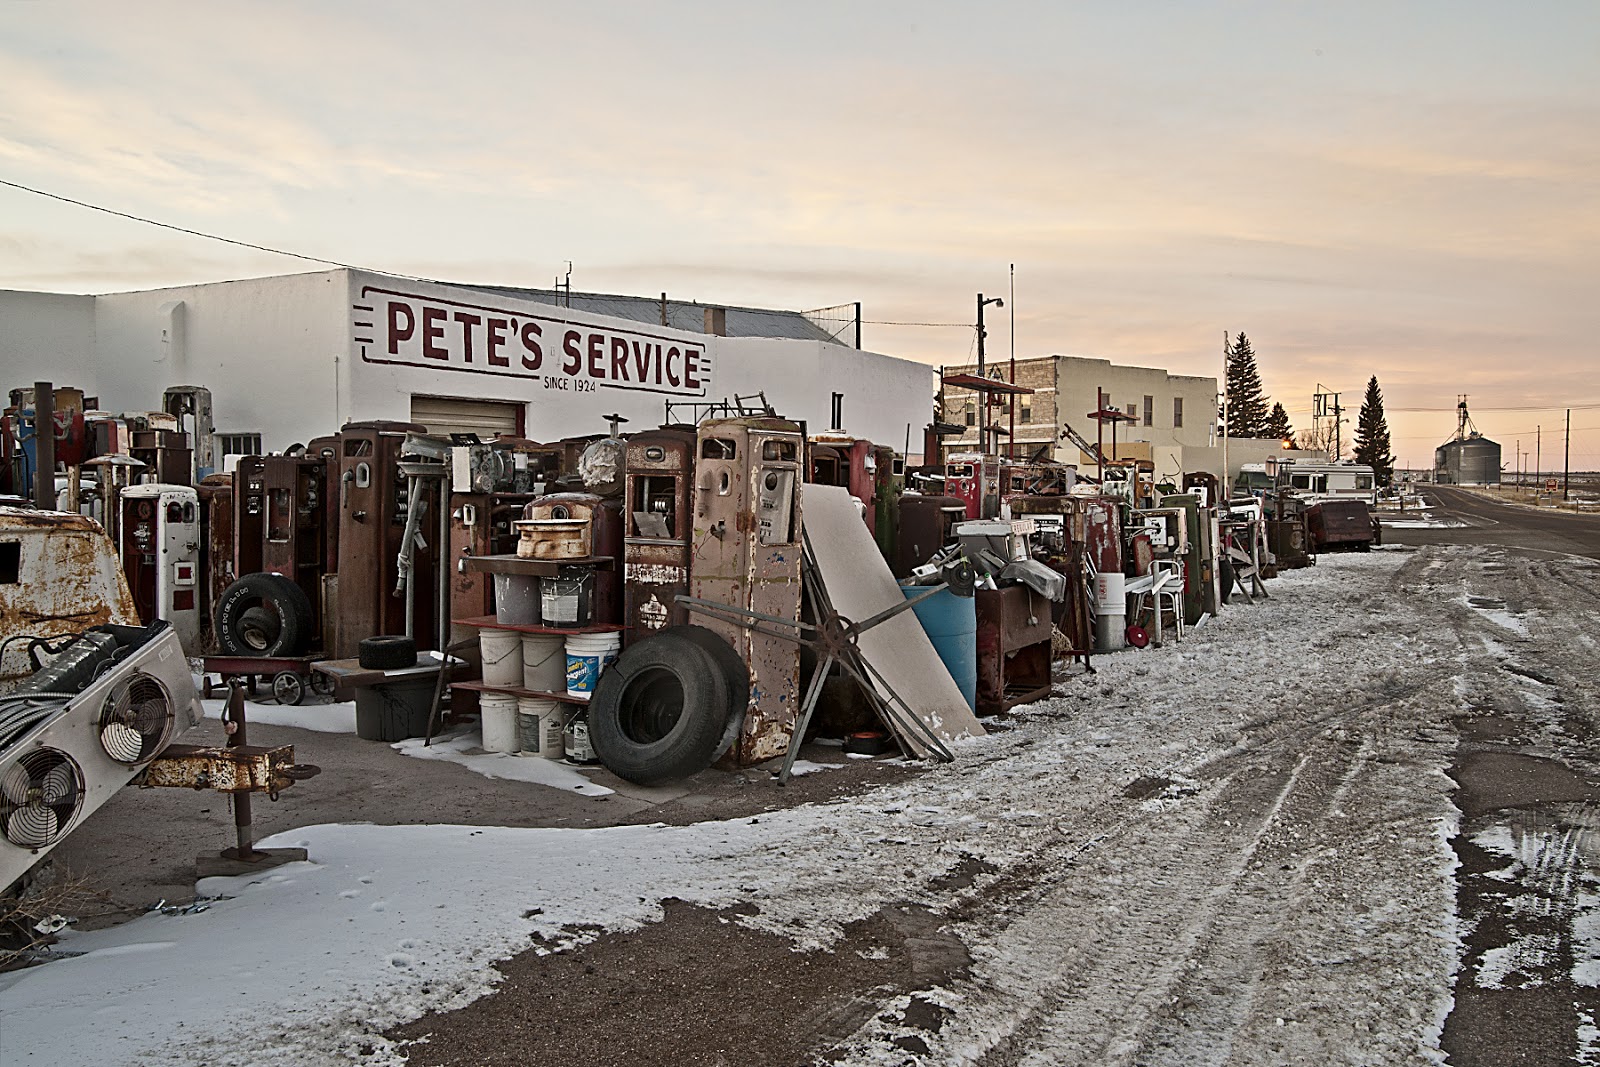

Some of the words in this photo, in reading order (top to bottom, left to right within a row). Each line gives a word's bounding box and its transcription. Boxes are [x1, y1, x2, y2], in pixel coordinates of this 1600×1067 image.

[388, 301, 543, 371] PETE'S
[562, 329, 701, 389] SERVICE
[543, 375, 569, 391] SINCE
[573, 378, 596, 393] 1924
